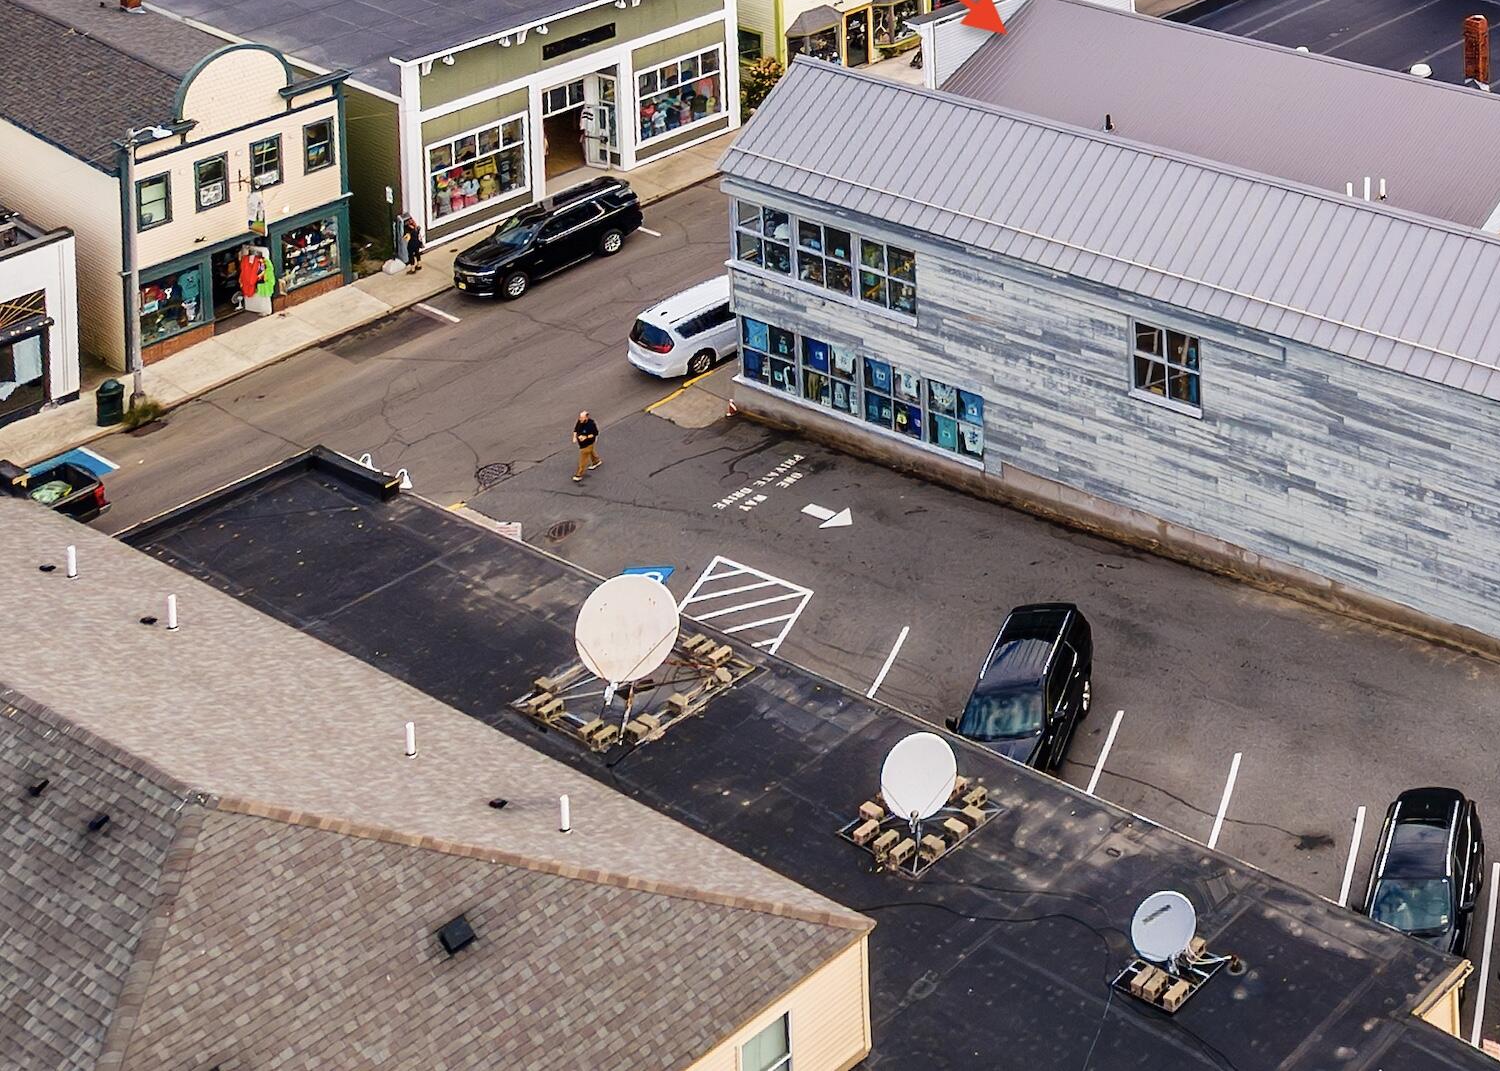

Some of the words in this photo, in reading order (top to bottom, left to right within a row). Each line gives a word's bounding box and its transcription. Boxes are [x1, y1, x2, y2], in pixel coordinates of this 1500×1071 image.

[753, 454, 805, 487] PRIVATE
[776, 472, 804, 489] ONE
[712, 487, 753, 510] DRIVE
[739, 494, 768, 512] WAY
